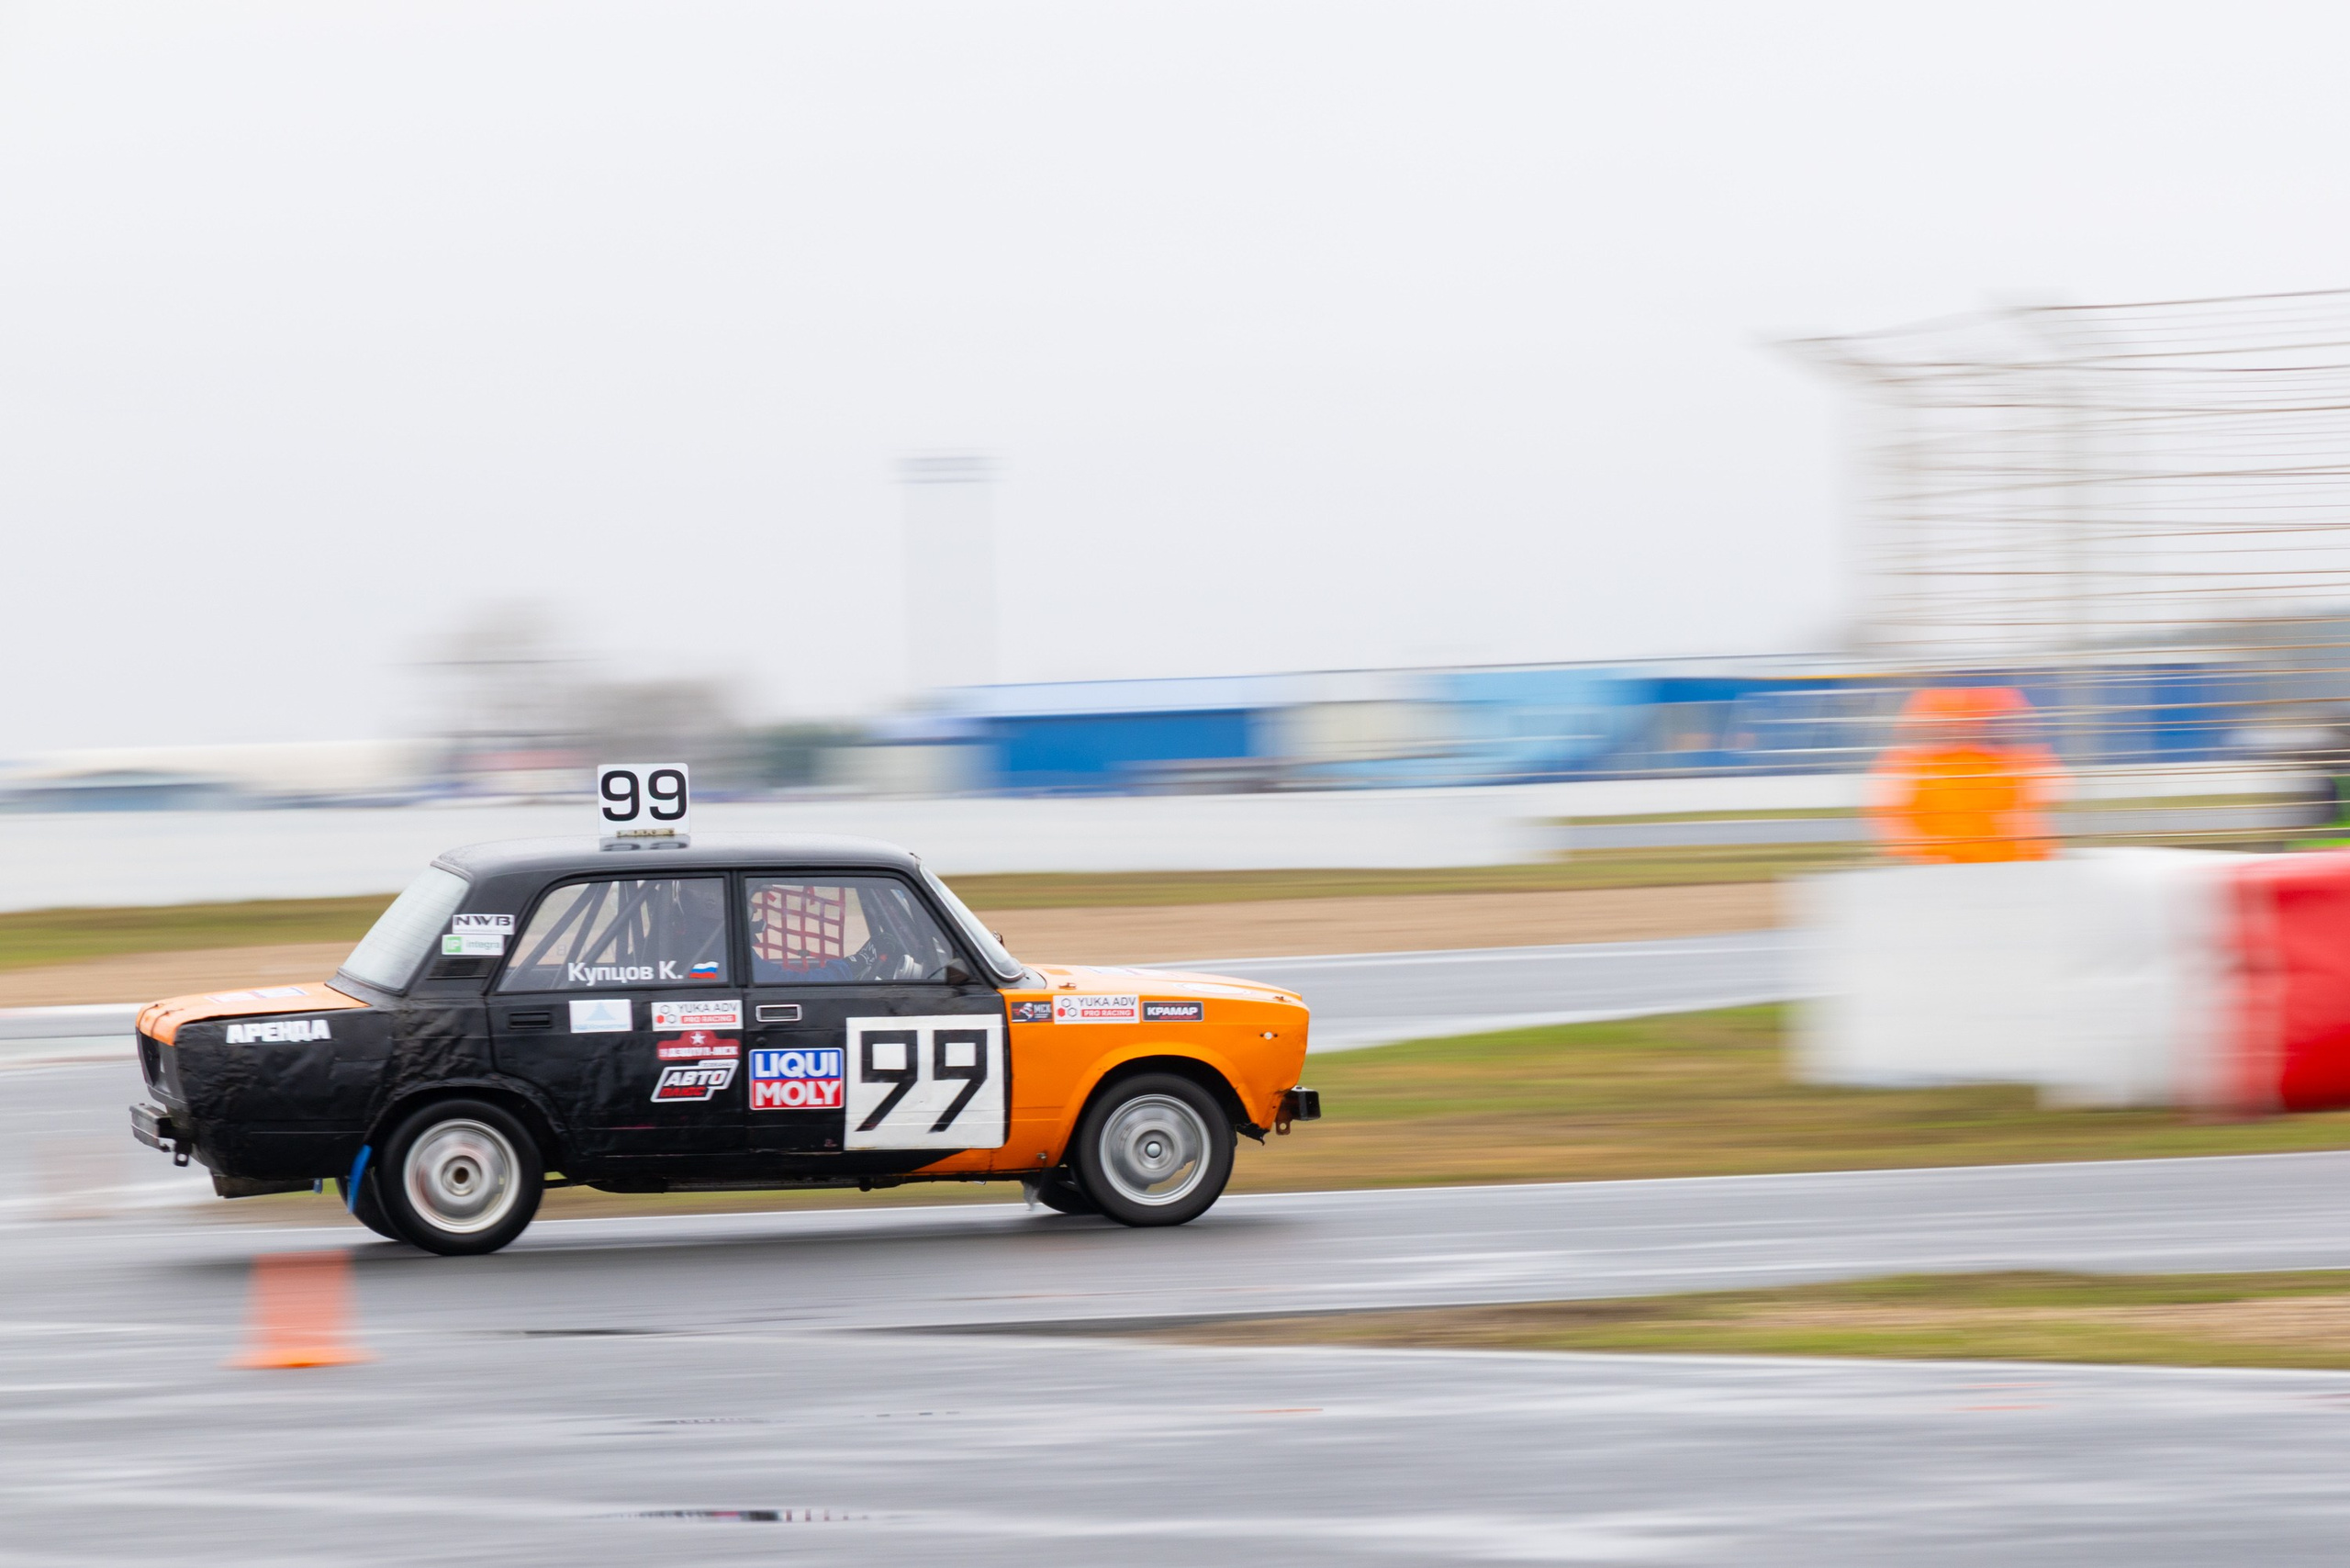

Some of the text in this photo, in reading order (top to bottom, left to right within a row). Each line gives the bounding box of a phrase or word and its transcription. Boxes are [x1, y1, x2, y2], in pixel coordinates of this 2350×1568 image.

[600, 768, 687, 822] 99
[454, 915, 511, 926] NWB
[466, 940, 500, 951] integra
[567, 960, 683, 986] Купцов К.
[677, 1002, 738, 1014] YUKA ADV
[1078, 996, 1136, 1007] YUKA ADV
[1147, 1006, 1198, 1016] КРАМАР
[226, 1019, 332, 1044] АРЕНДА
[755, 1051, 839, 1079] LIQUI
[663, 1070, 728, 1087] АВТО
[854, 1029, 988, 1134] 99
[755, 1081, 841, 1106] MOLY
